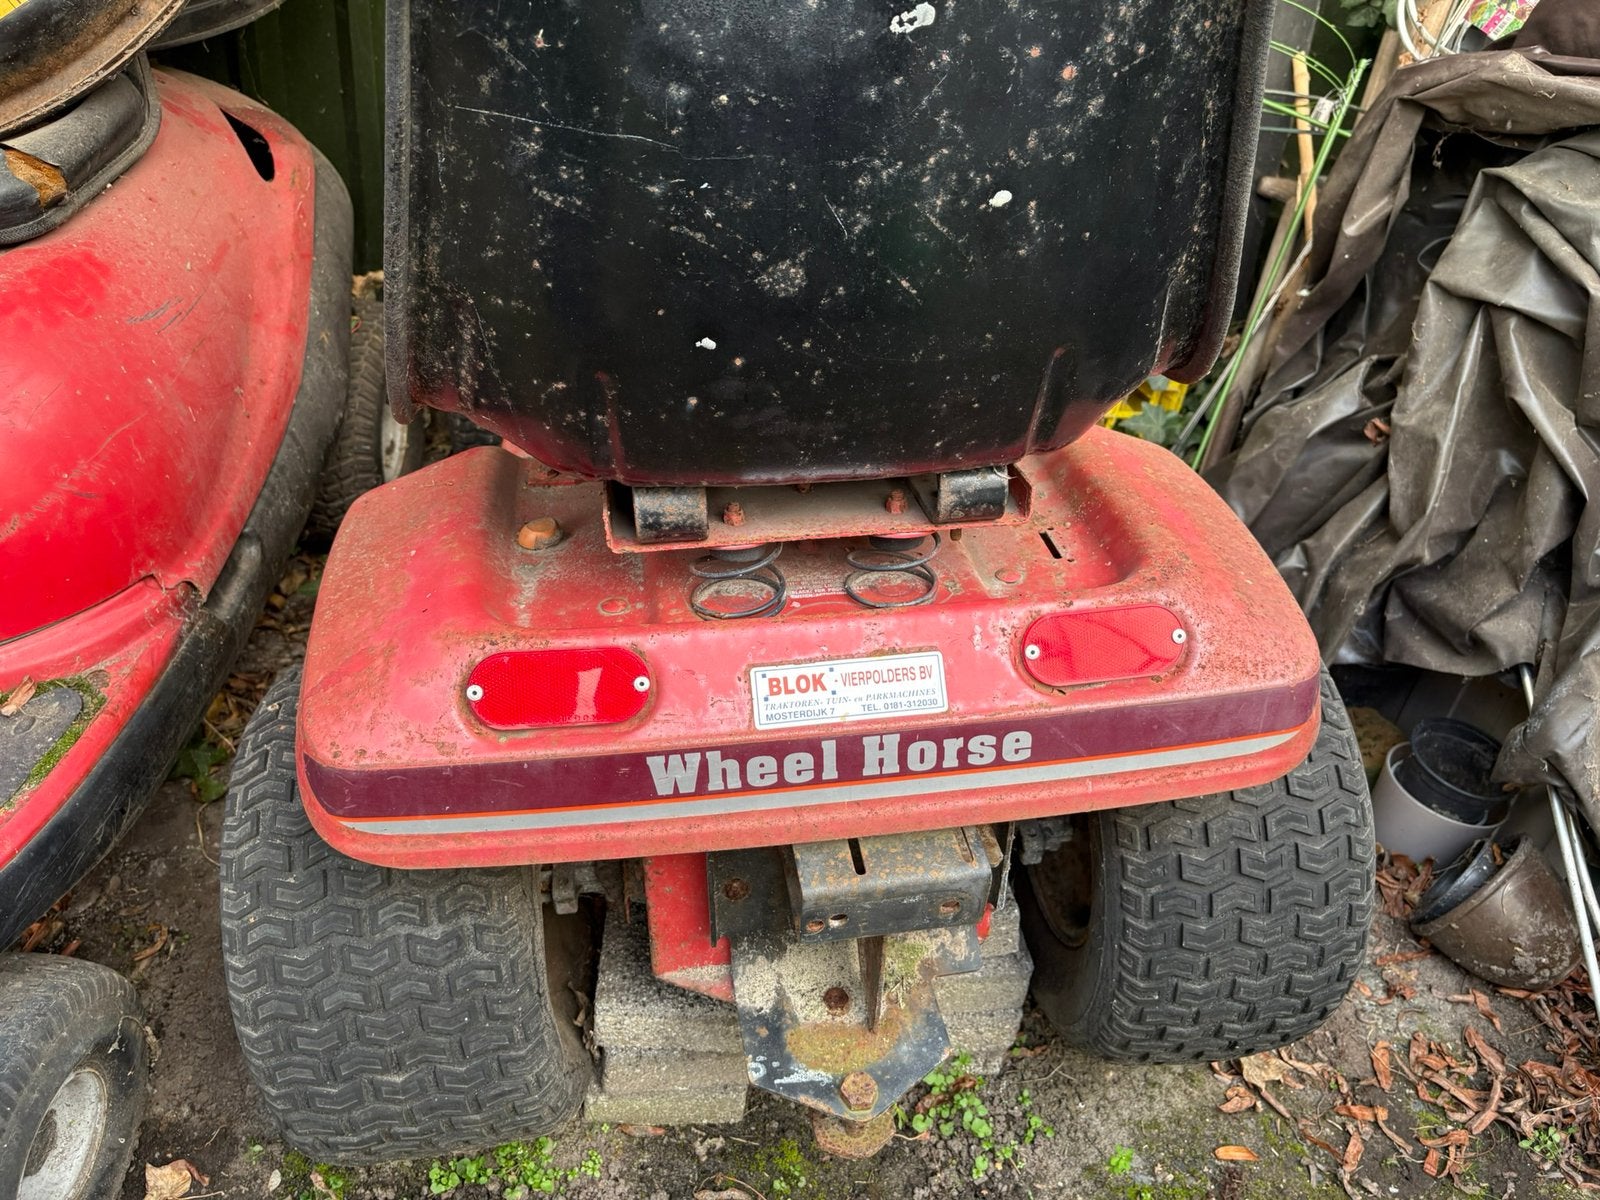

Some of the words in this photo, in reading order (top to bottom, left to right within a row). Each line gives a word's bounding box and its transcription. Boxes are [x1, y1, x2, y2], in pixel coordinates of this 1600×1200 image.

[767, 672, 828, 696] BLOK
[840, 667, 917, 687] VIERPOLDERS
[919, 664, 933, 680] BV
[764, 699, 823, 710] TRAKTOREN-
[826, 697, 852, 706] TUIN-
[865, 688, 936, 702] PARKMACHINES
[765, 710, 828, 721] MOSTERDIJK
[829, 707, 836, 716] 7
[861, 703, 881, 712] TEL.
[883, 698, 938, 710] 0181-312030
[646, 740, 838, 796] Wheel
[863, 730, 1034, 776] Horse
